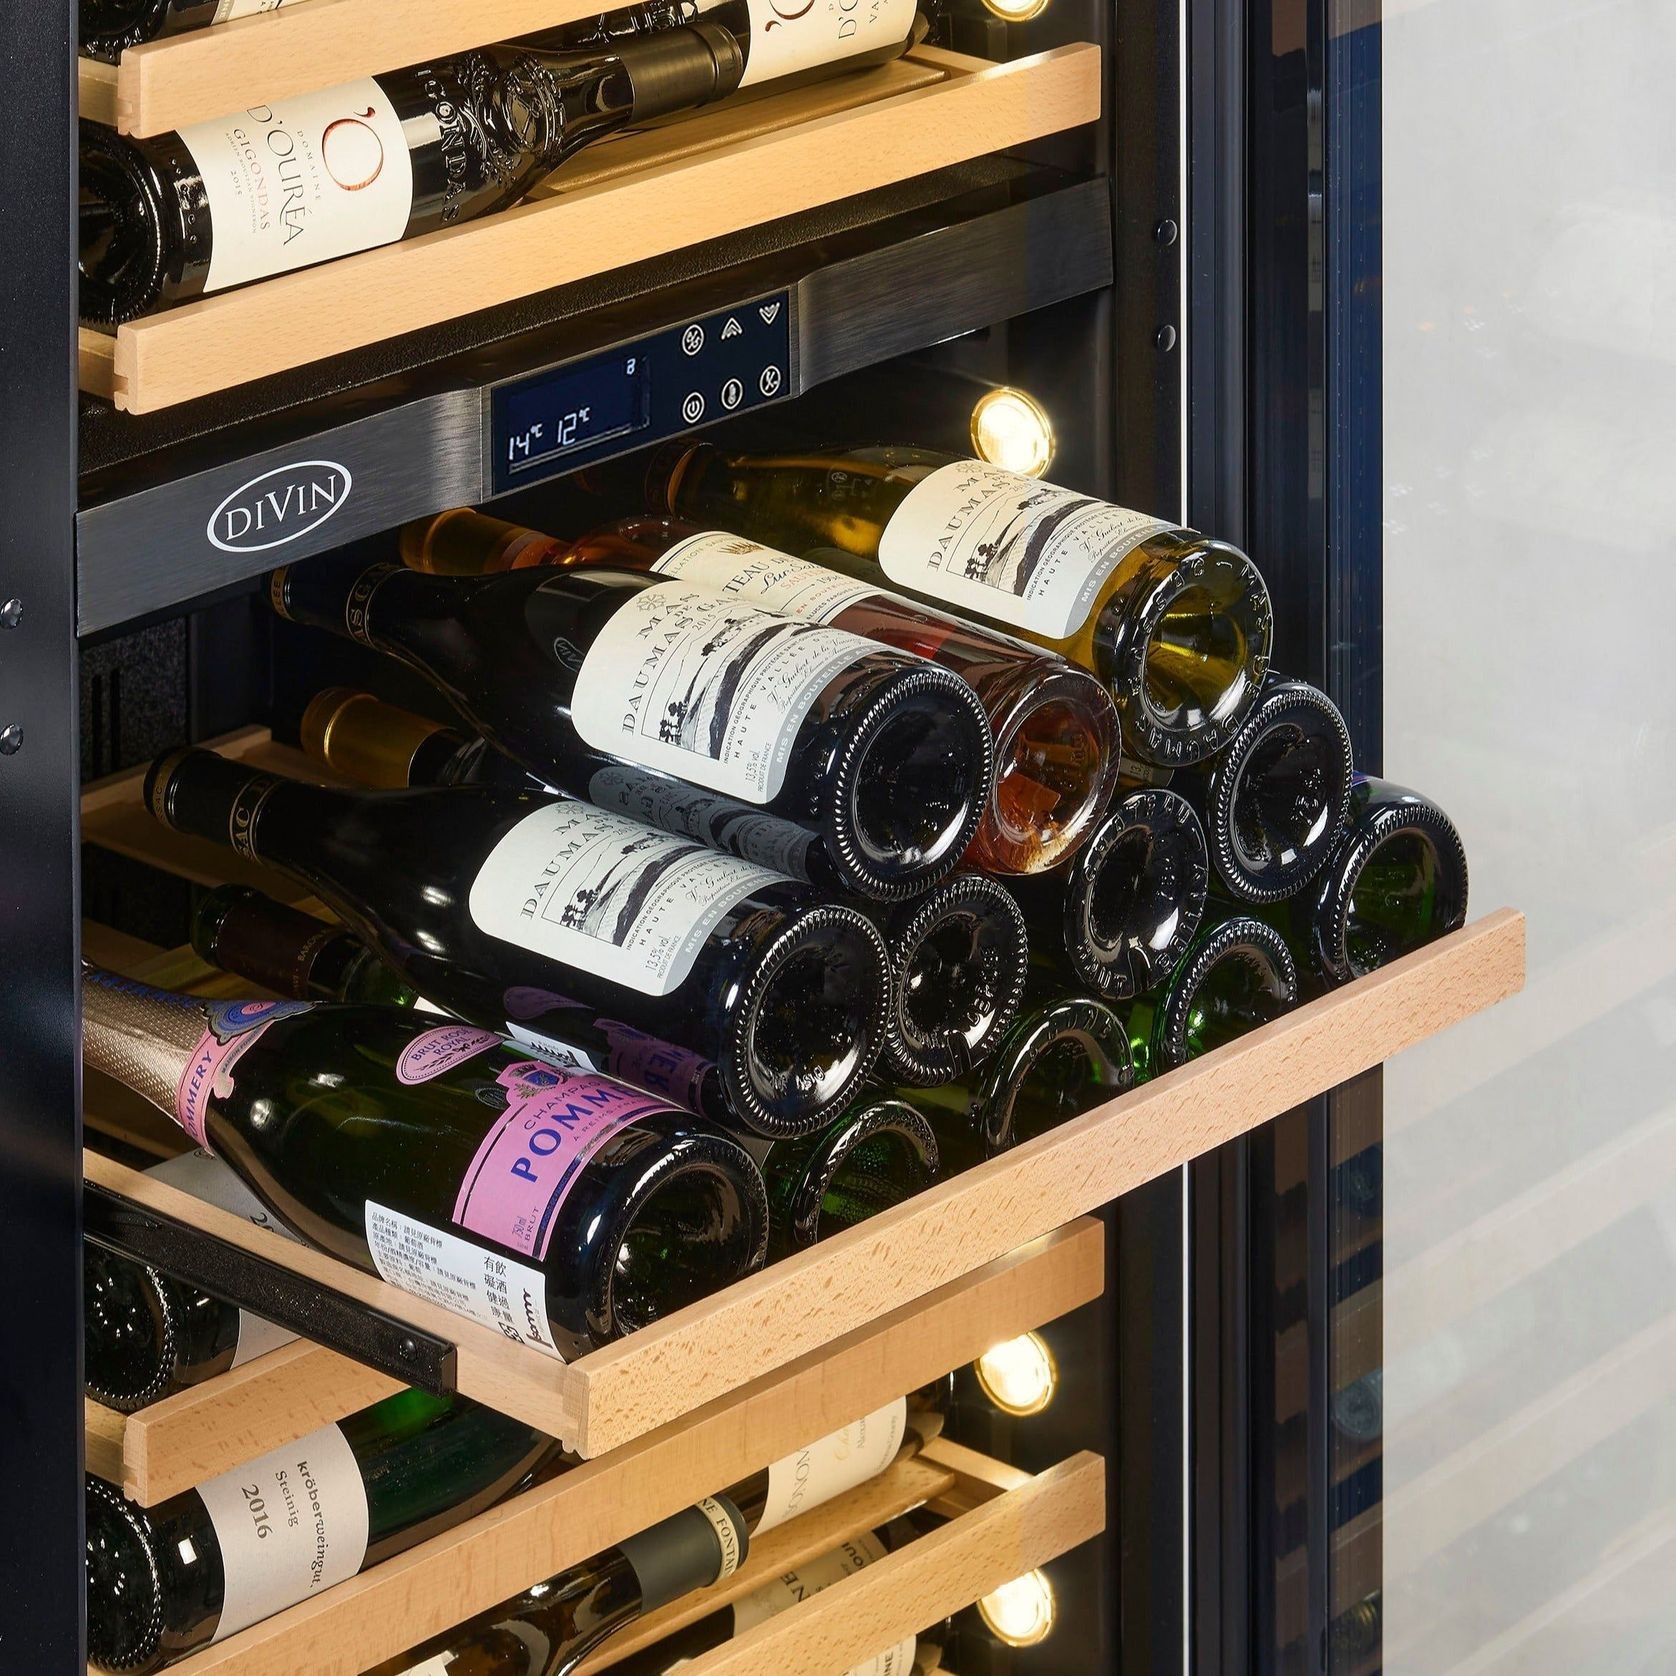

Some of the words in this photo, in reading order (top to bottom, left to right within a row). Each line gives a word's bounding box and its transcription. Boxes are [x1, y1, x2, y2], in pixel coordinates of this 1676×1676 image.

[233, 129, 271, 231] GIGONDAS
[247, 105, 313, 246] D'OURÉA
[1038, 549, 1068, 596] HAUTE
[1081, 579, 1097, 603] MIS
[1095, 560, 1110, 577] EN
[734, 704, 757, 759] HAUTE
[776, 736, 789, 764] MIS
[787, 714, 800, 733] EN
[639, 897, 675, 947] HAUTE
[685, 929, 701, 954] MIS
[702, 909, 717, 927] EN
[411, 1040, 441, 1061] BRUT
[433, 1036, 472, 1056] ROYAL
[525, 1206, 540, 1241] BRUT
[241, 1484, 274, 1540] 2016
[275, 1470, 299, 1528] Steinig
